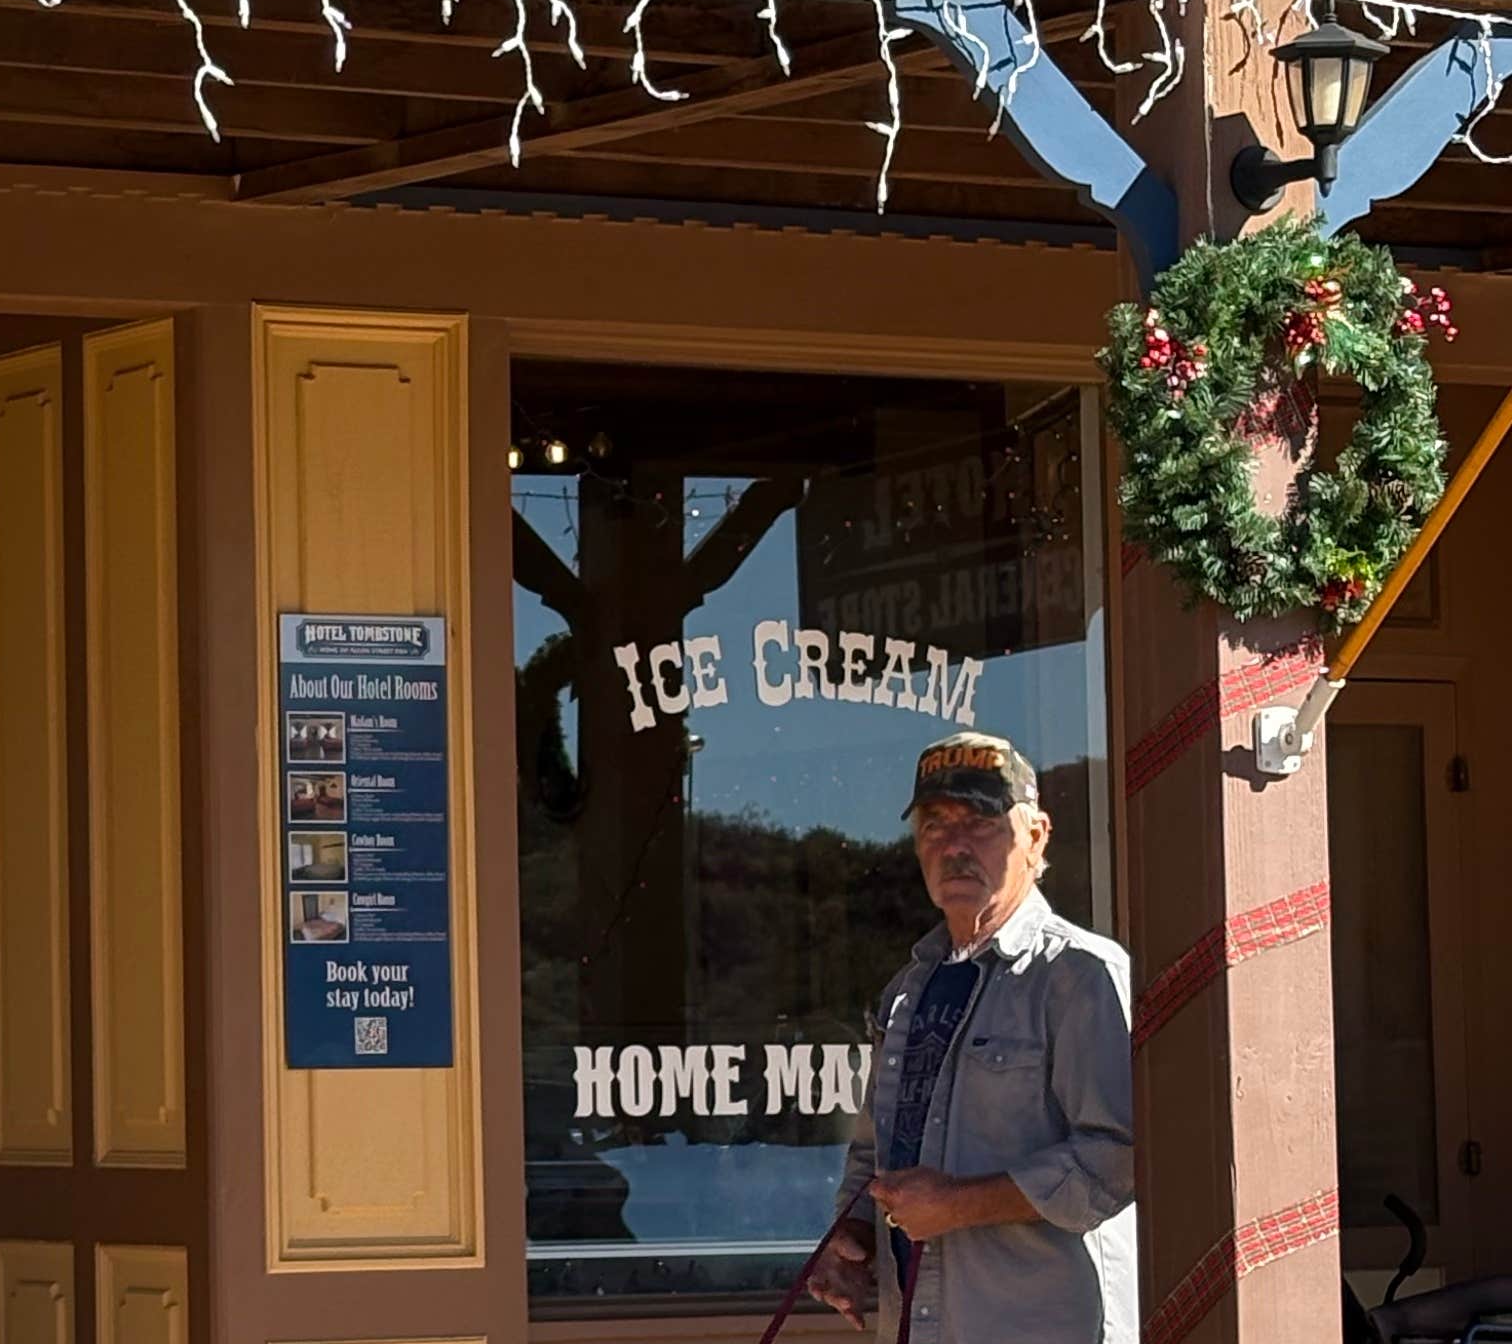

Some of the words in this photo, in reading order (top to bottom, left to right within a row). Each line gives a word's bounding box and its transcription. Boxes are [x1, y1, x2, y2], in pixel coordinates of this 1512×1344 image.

[305, 624, 346, 644] HOTEL
[349, 625, 423, 646] TOMBSTONE
[289, 673, 328, 699] About
[331, 674, 354, 700] Our
[357, 674, 392, 700] Hotel
[394, 675, 438, 701] Rooms
[613, 635, 728, 733] ICE
[752, 619, 984, 727] CREAM
[919, 747, 1005, 778] TRUMP
[326, 960, 368, 982] Book
[372, 964, 409, 985] your
[326, 987, 359, 1011] stay
[364, 986, 415, 1011] today!
[573, 1044, 748, 1118] HOME
[764, 1043, 873, 1116] MA
